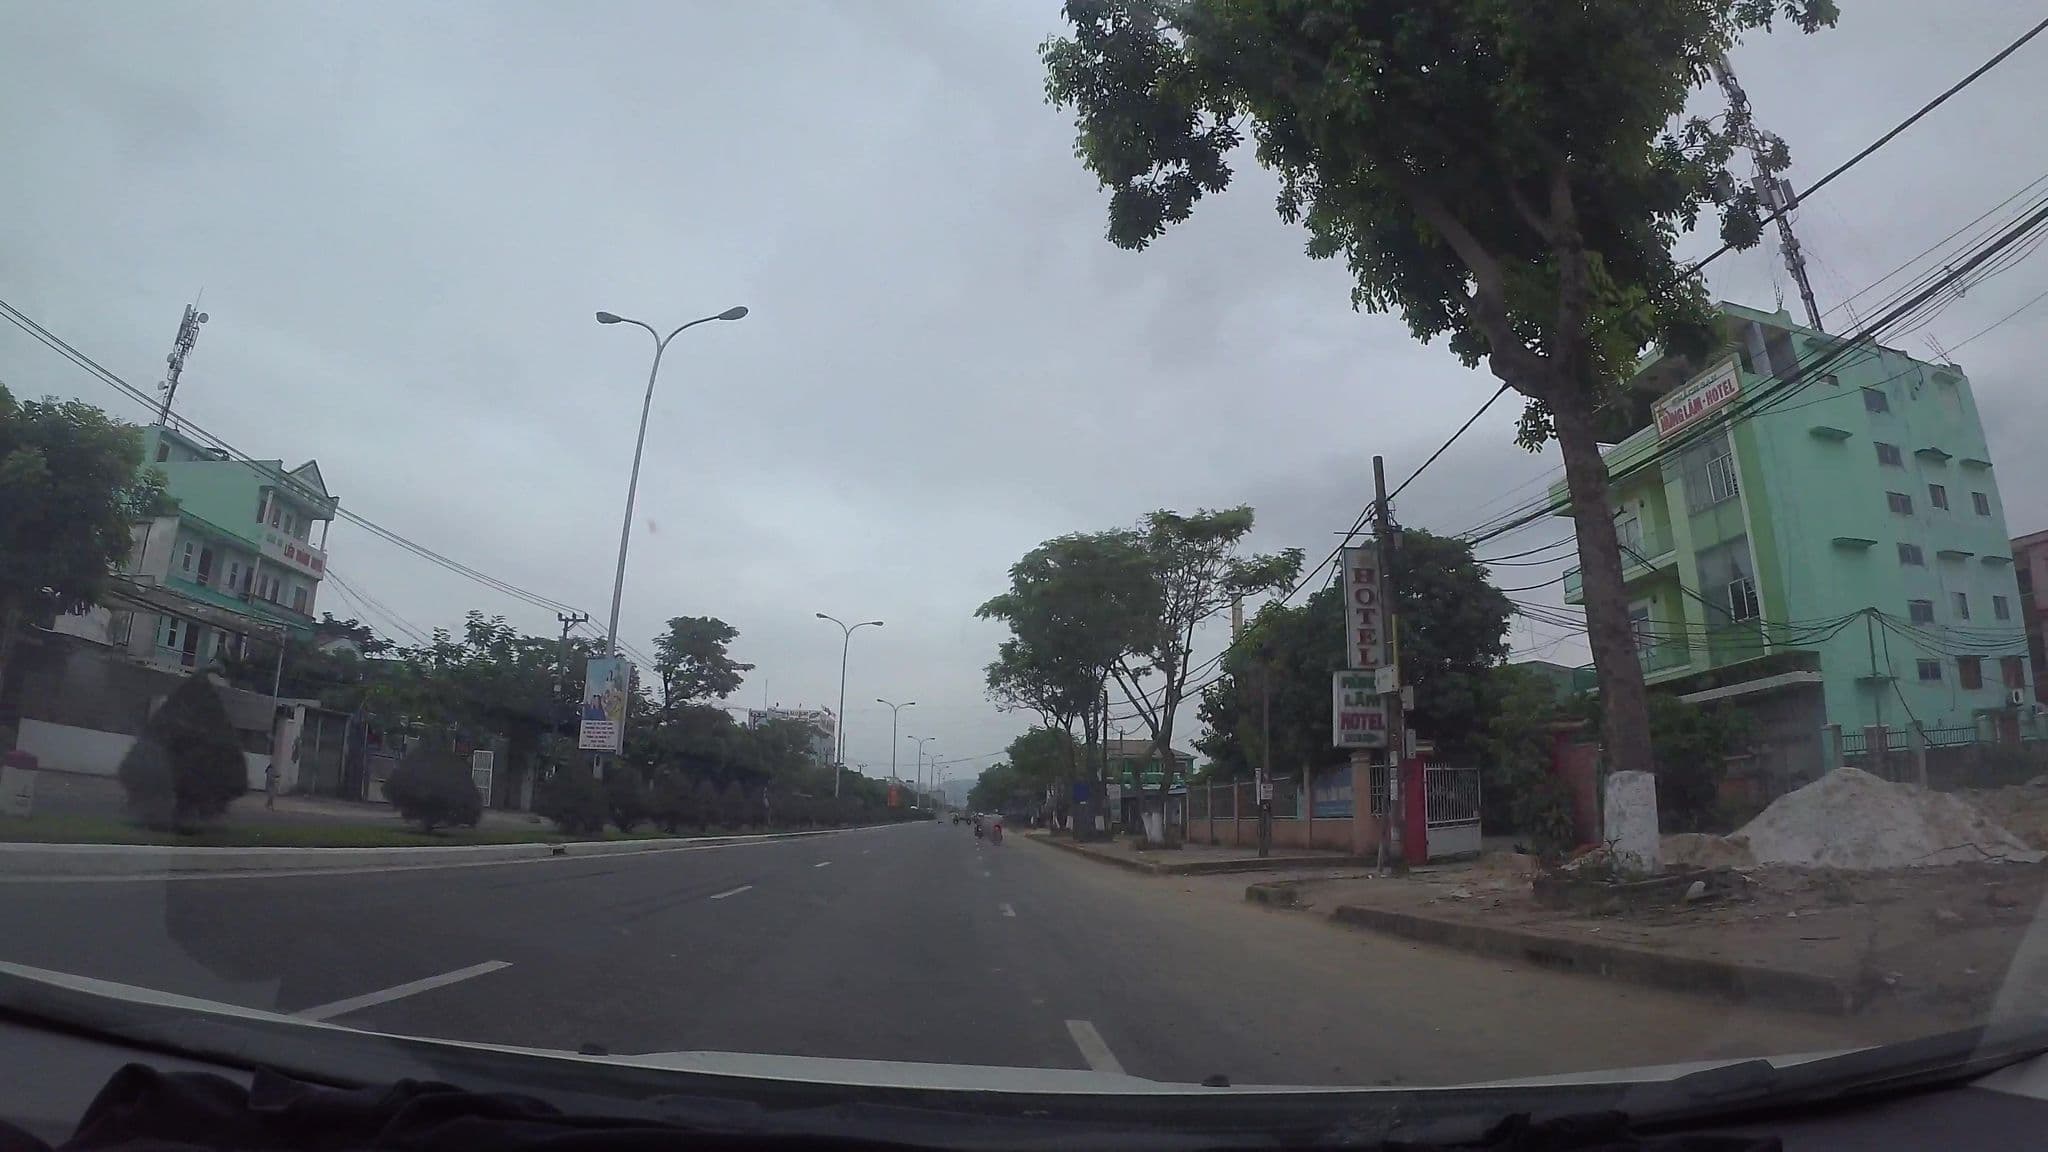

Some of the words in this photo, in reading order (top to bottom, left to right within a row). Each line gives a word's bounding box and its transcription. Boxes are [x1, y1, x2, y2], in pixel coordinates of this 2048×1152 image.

[1706, 378, 1736, 406] HOTEL
[1352, 568, 1378, 667] HOTEL
[1344, 691, 1382, 707] LÂM
[1340, 712, 1385, 730] HOTEL
